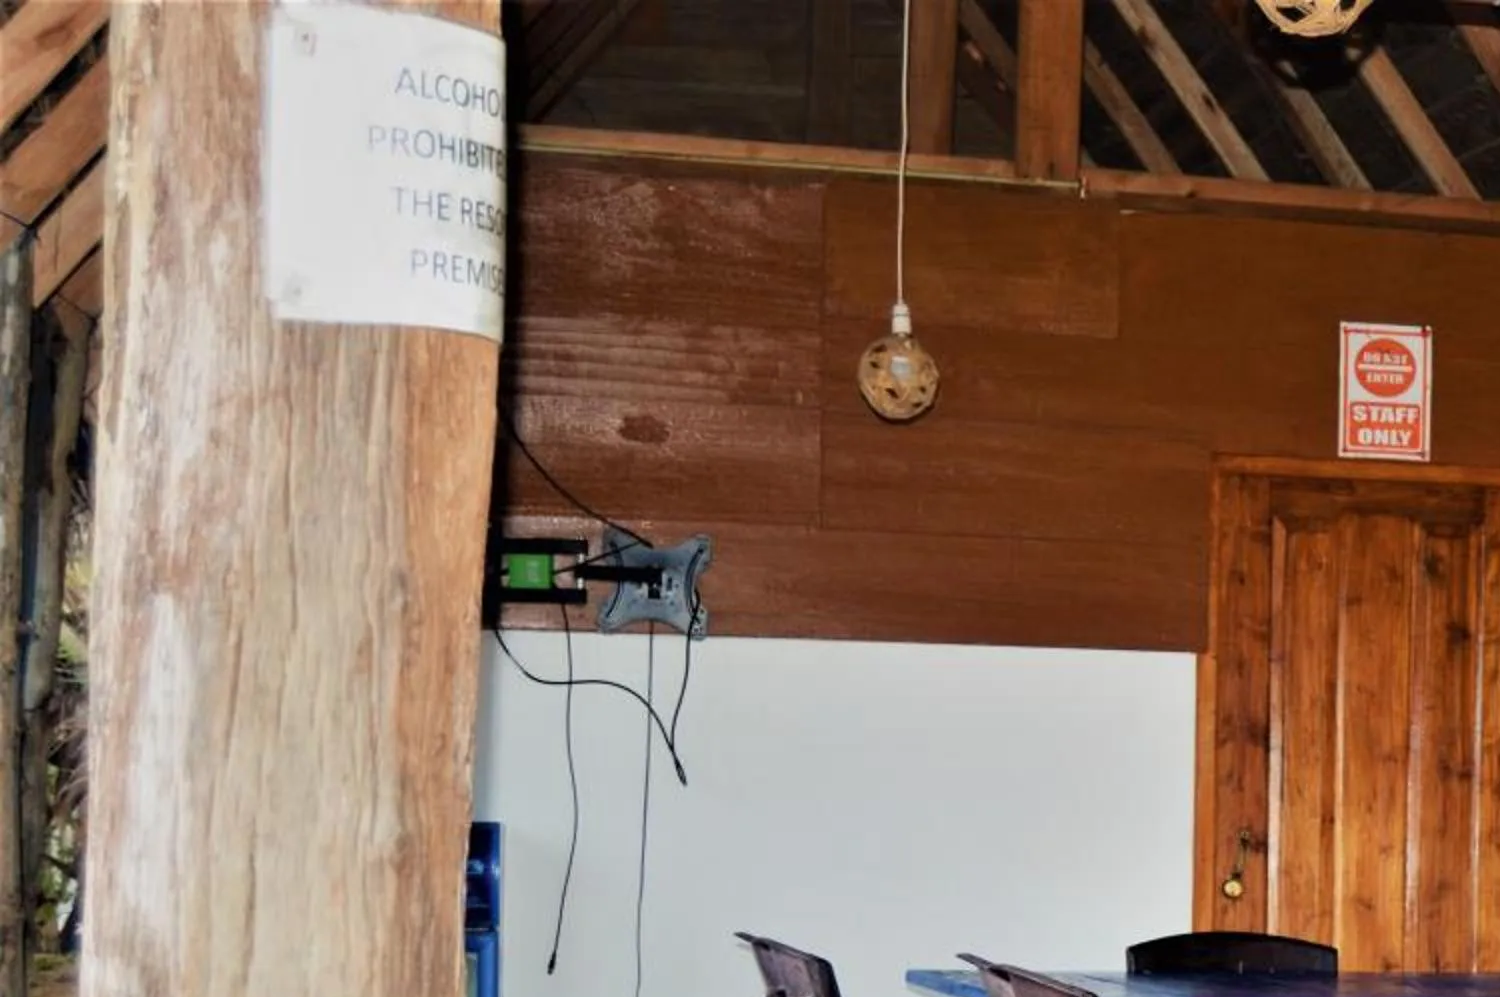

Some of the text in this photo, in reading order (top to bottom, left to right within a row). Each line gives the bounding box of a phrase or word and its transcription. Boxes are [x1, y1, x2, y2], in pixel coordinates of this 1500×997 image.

[367, 125, 506, 182] PROHIBITE
[391, 187, 505, 237] THE RESO
[411, 249, 505, 297] PREMISE
[1366, 371, 1405, 385] ENTER
[1352, 404, 1420, 425] STAFF
[1357, 427, 1413, 447] ONLY
